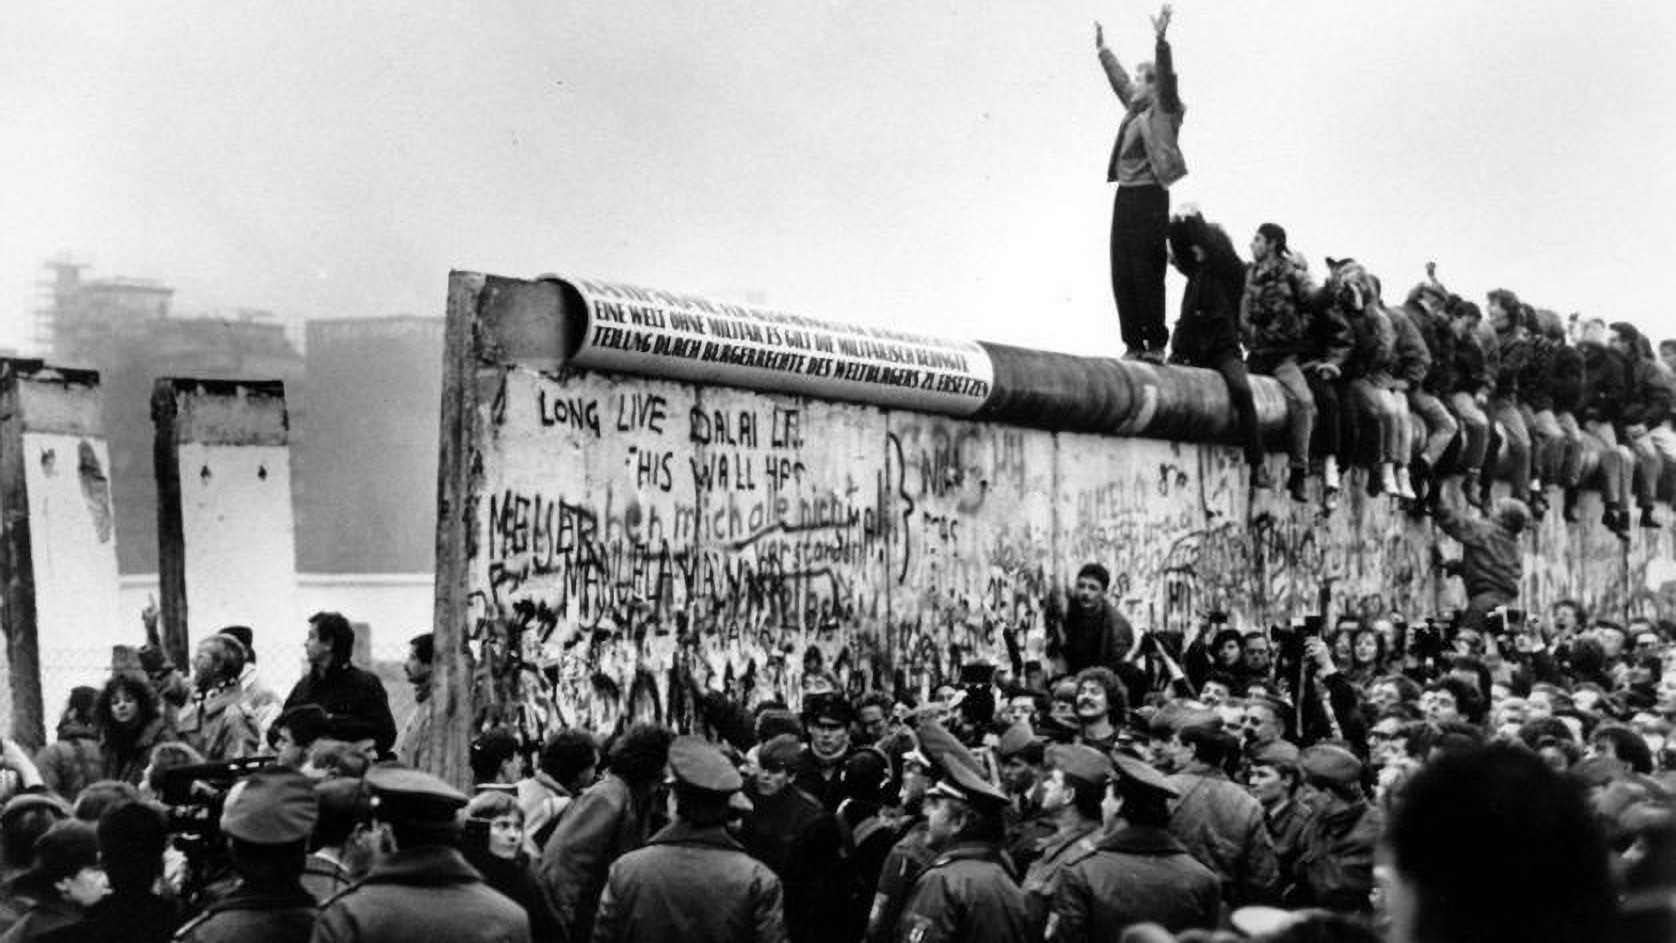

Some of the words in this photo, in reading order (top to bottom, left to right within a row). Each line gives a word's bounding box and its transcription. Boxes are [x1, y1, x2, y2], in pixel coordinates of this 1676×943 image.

[593, 299, 626, 324] EINE
[627, 305, 665, 329] WELT
[669, 310, 706, 335] OHNE
[591, 324, 654, 353] TEILUNG
[652, 333, 702, 360] DURCH
[806, 356, 834, 377] DES
[539, 389, 601, 439] LONG
[617, 391, 667, 435] LIVE
[689, 404, 757, 448] DALAI
[688, 452, 755, 492] WALL
